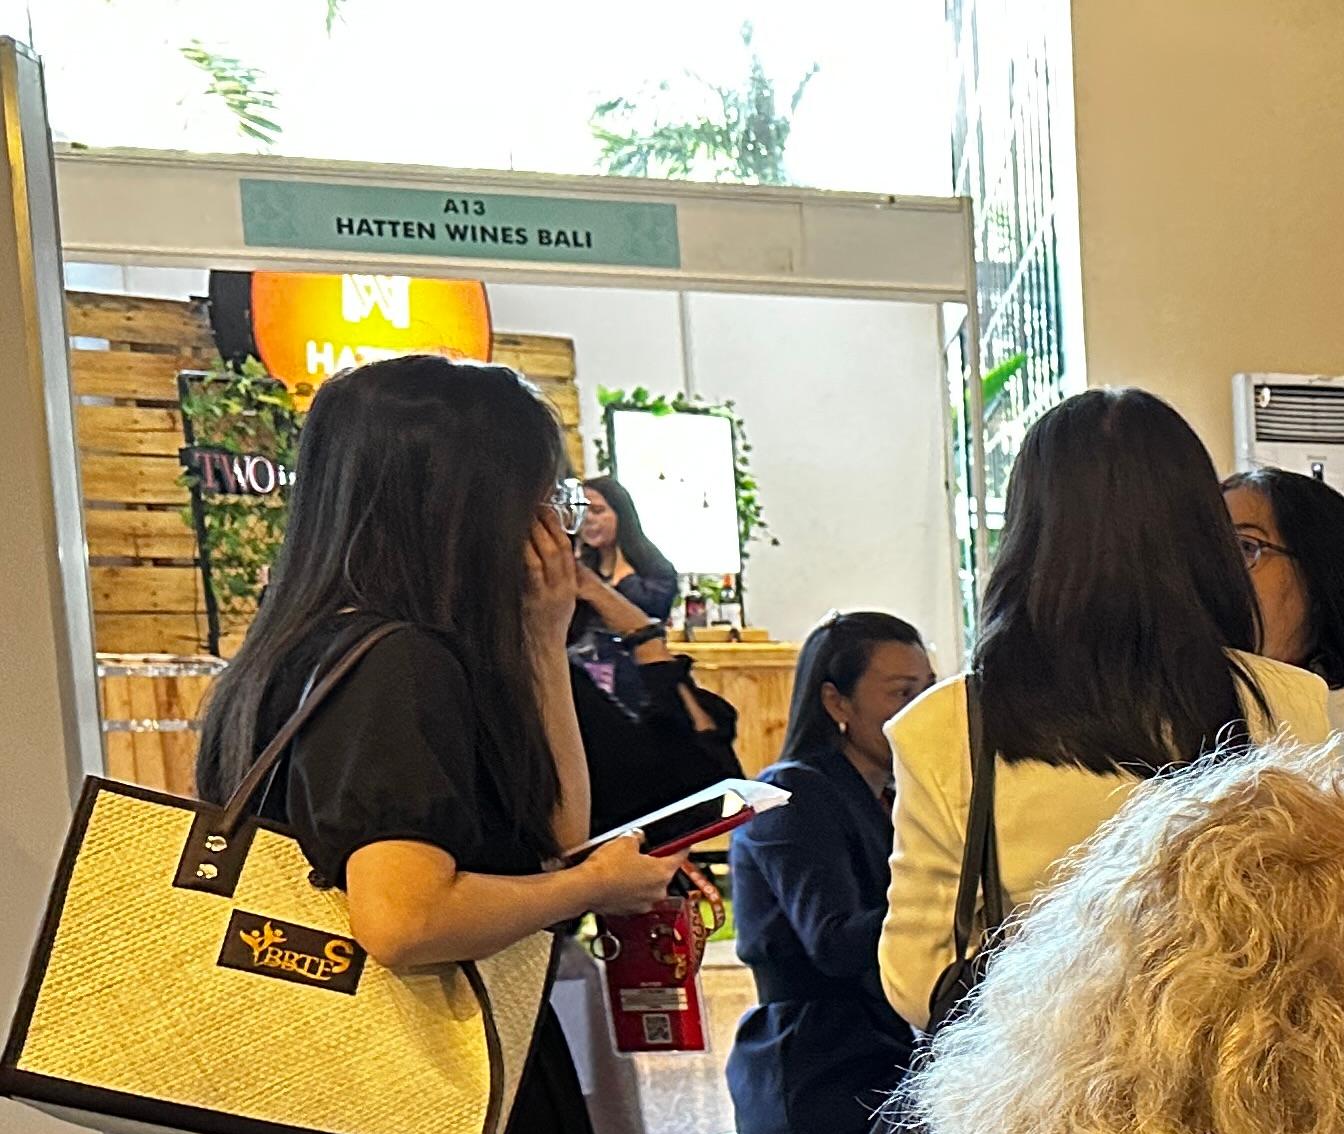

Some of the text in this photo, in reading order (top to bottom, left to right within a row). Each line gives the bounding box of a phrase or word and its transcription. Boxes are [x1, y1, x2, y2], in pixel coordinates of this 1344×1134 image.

[443, 199, 486, 216] A13
[336, 216, 593, 249] HATTEN WINES BALI
[195, 452, 275, 494] TWO
